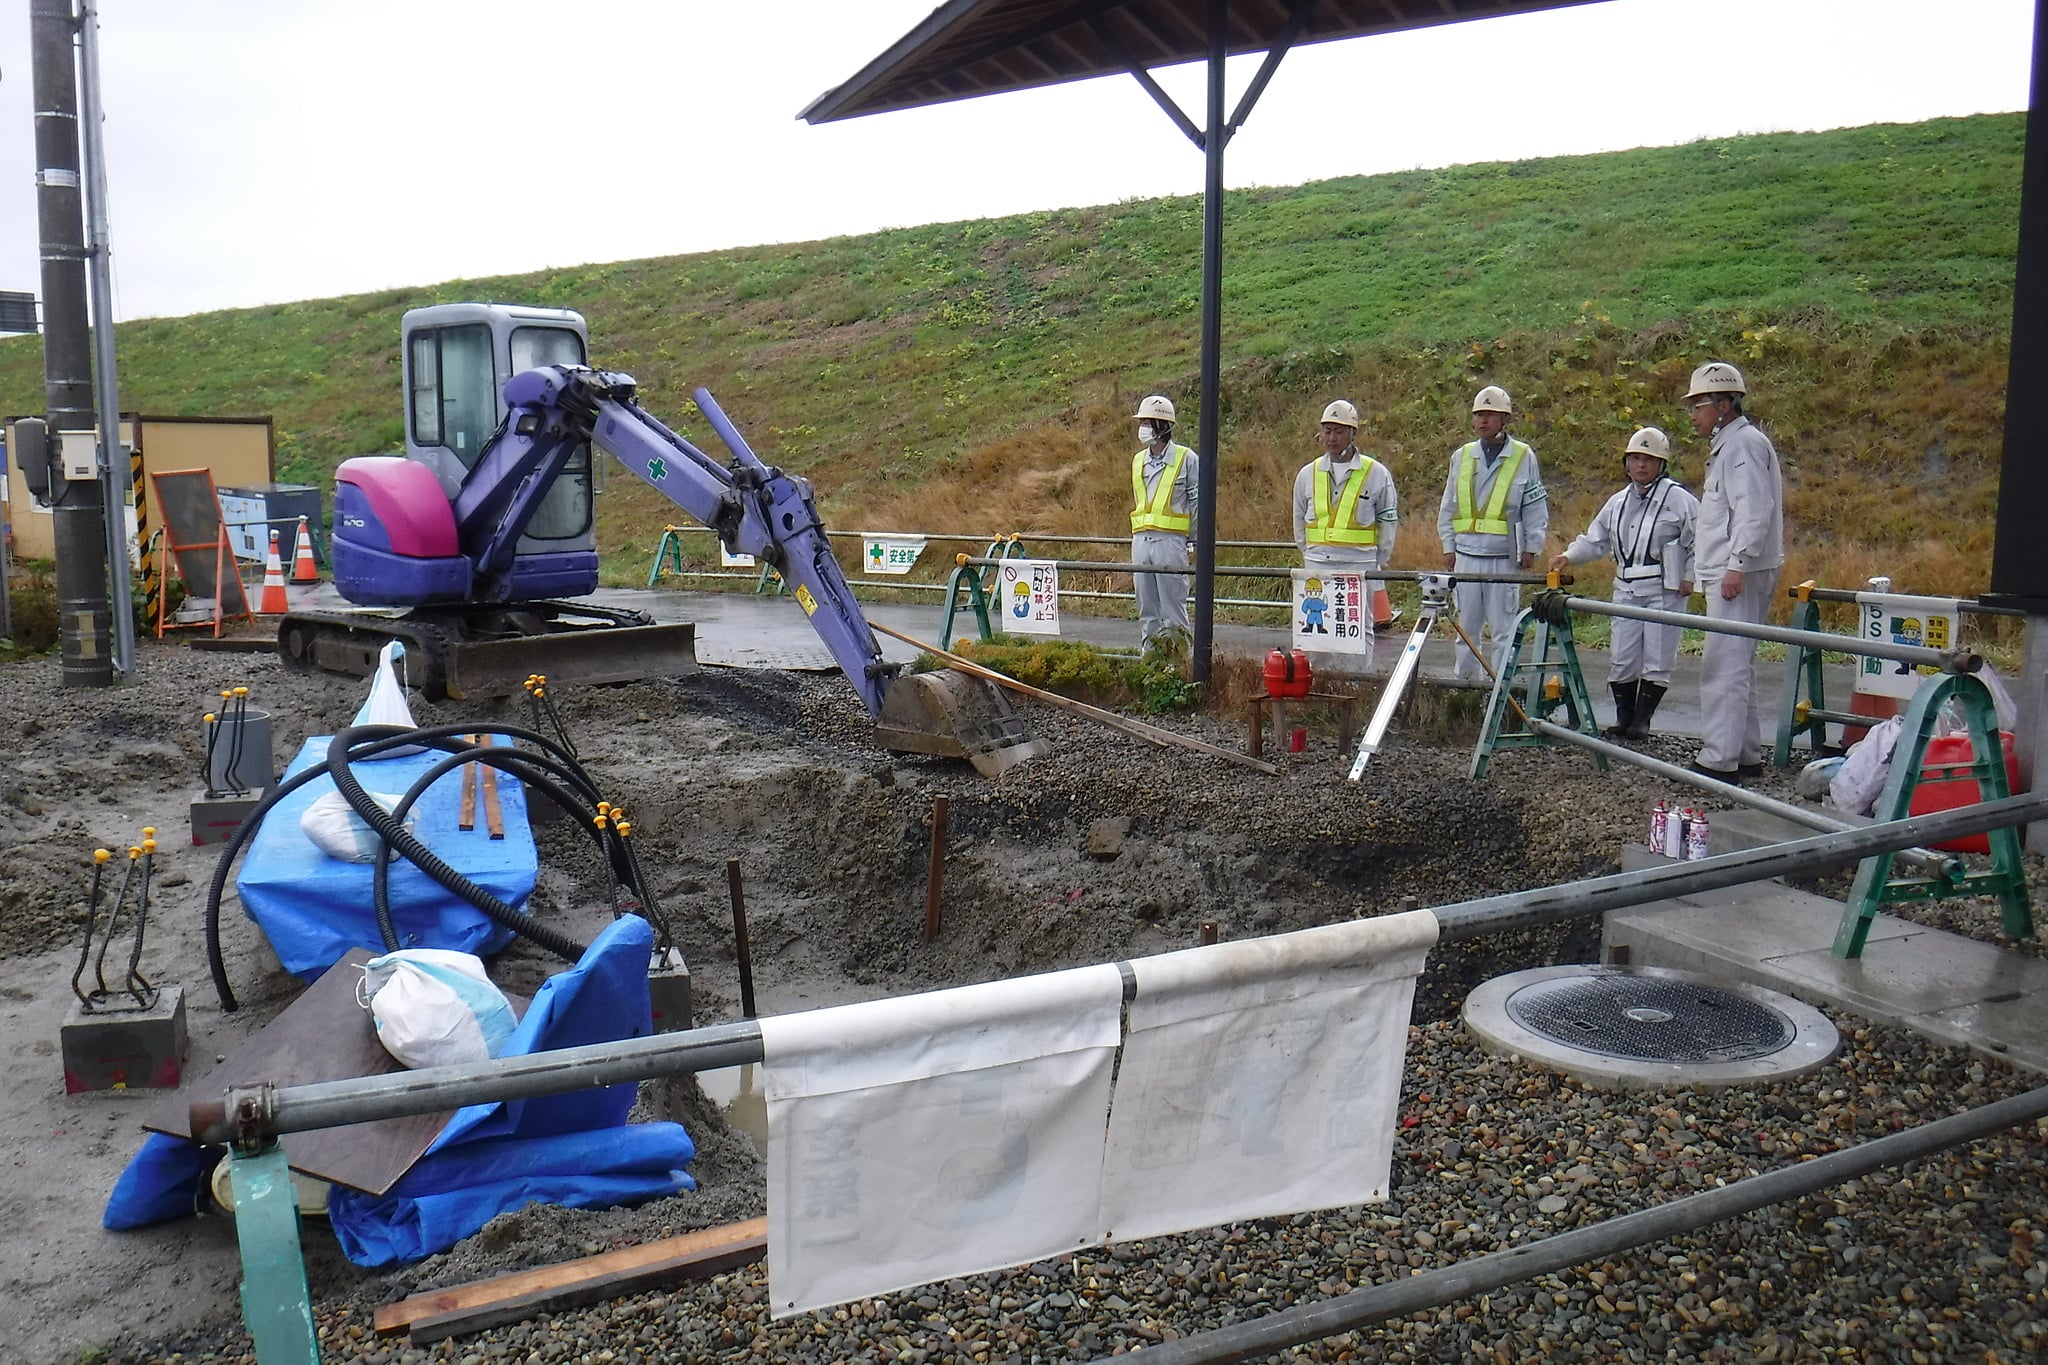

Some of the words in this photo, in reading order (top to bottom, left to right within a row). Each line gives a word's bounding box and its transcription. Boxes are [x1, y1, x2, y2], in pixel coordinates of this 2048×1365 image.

[1044, 566, 1055, 621] くわえタバコ
[1334, 577, 1346, 638] 完全着用
[1347, 577, 1360, 638] 保護具の
